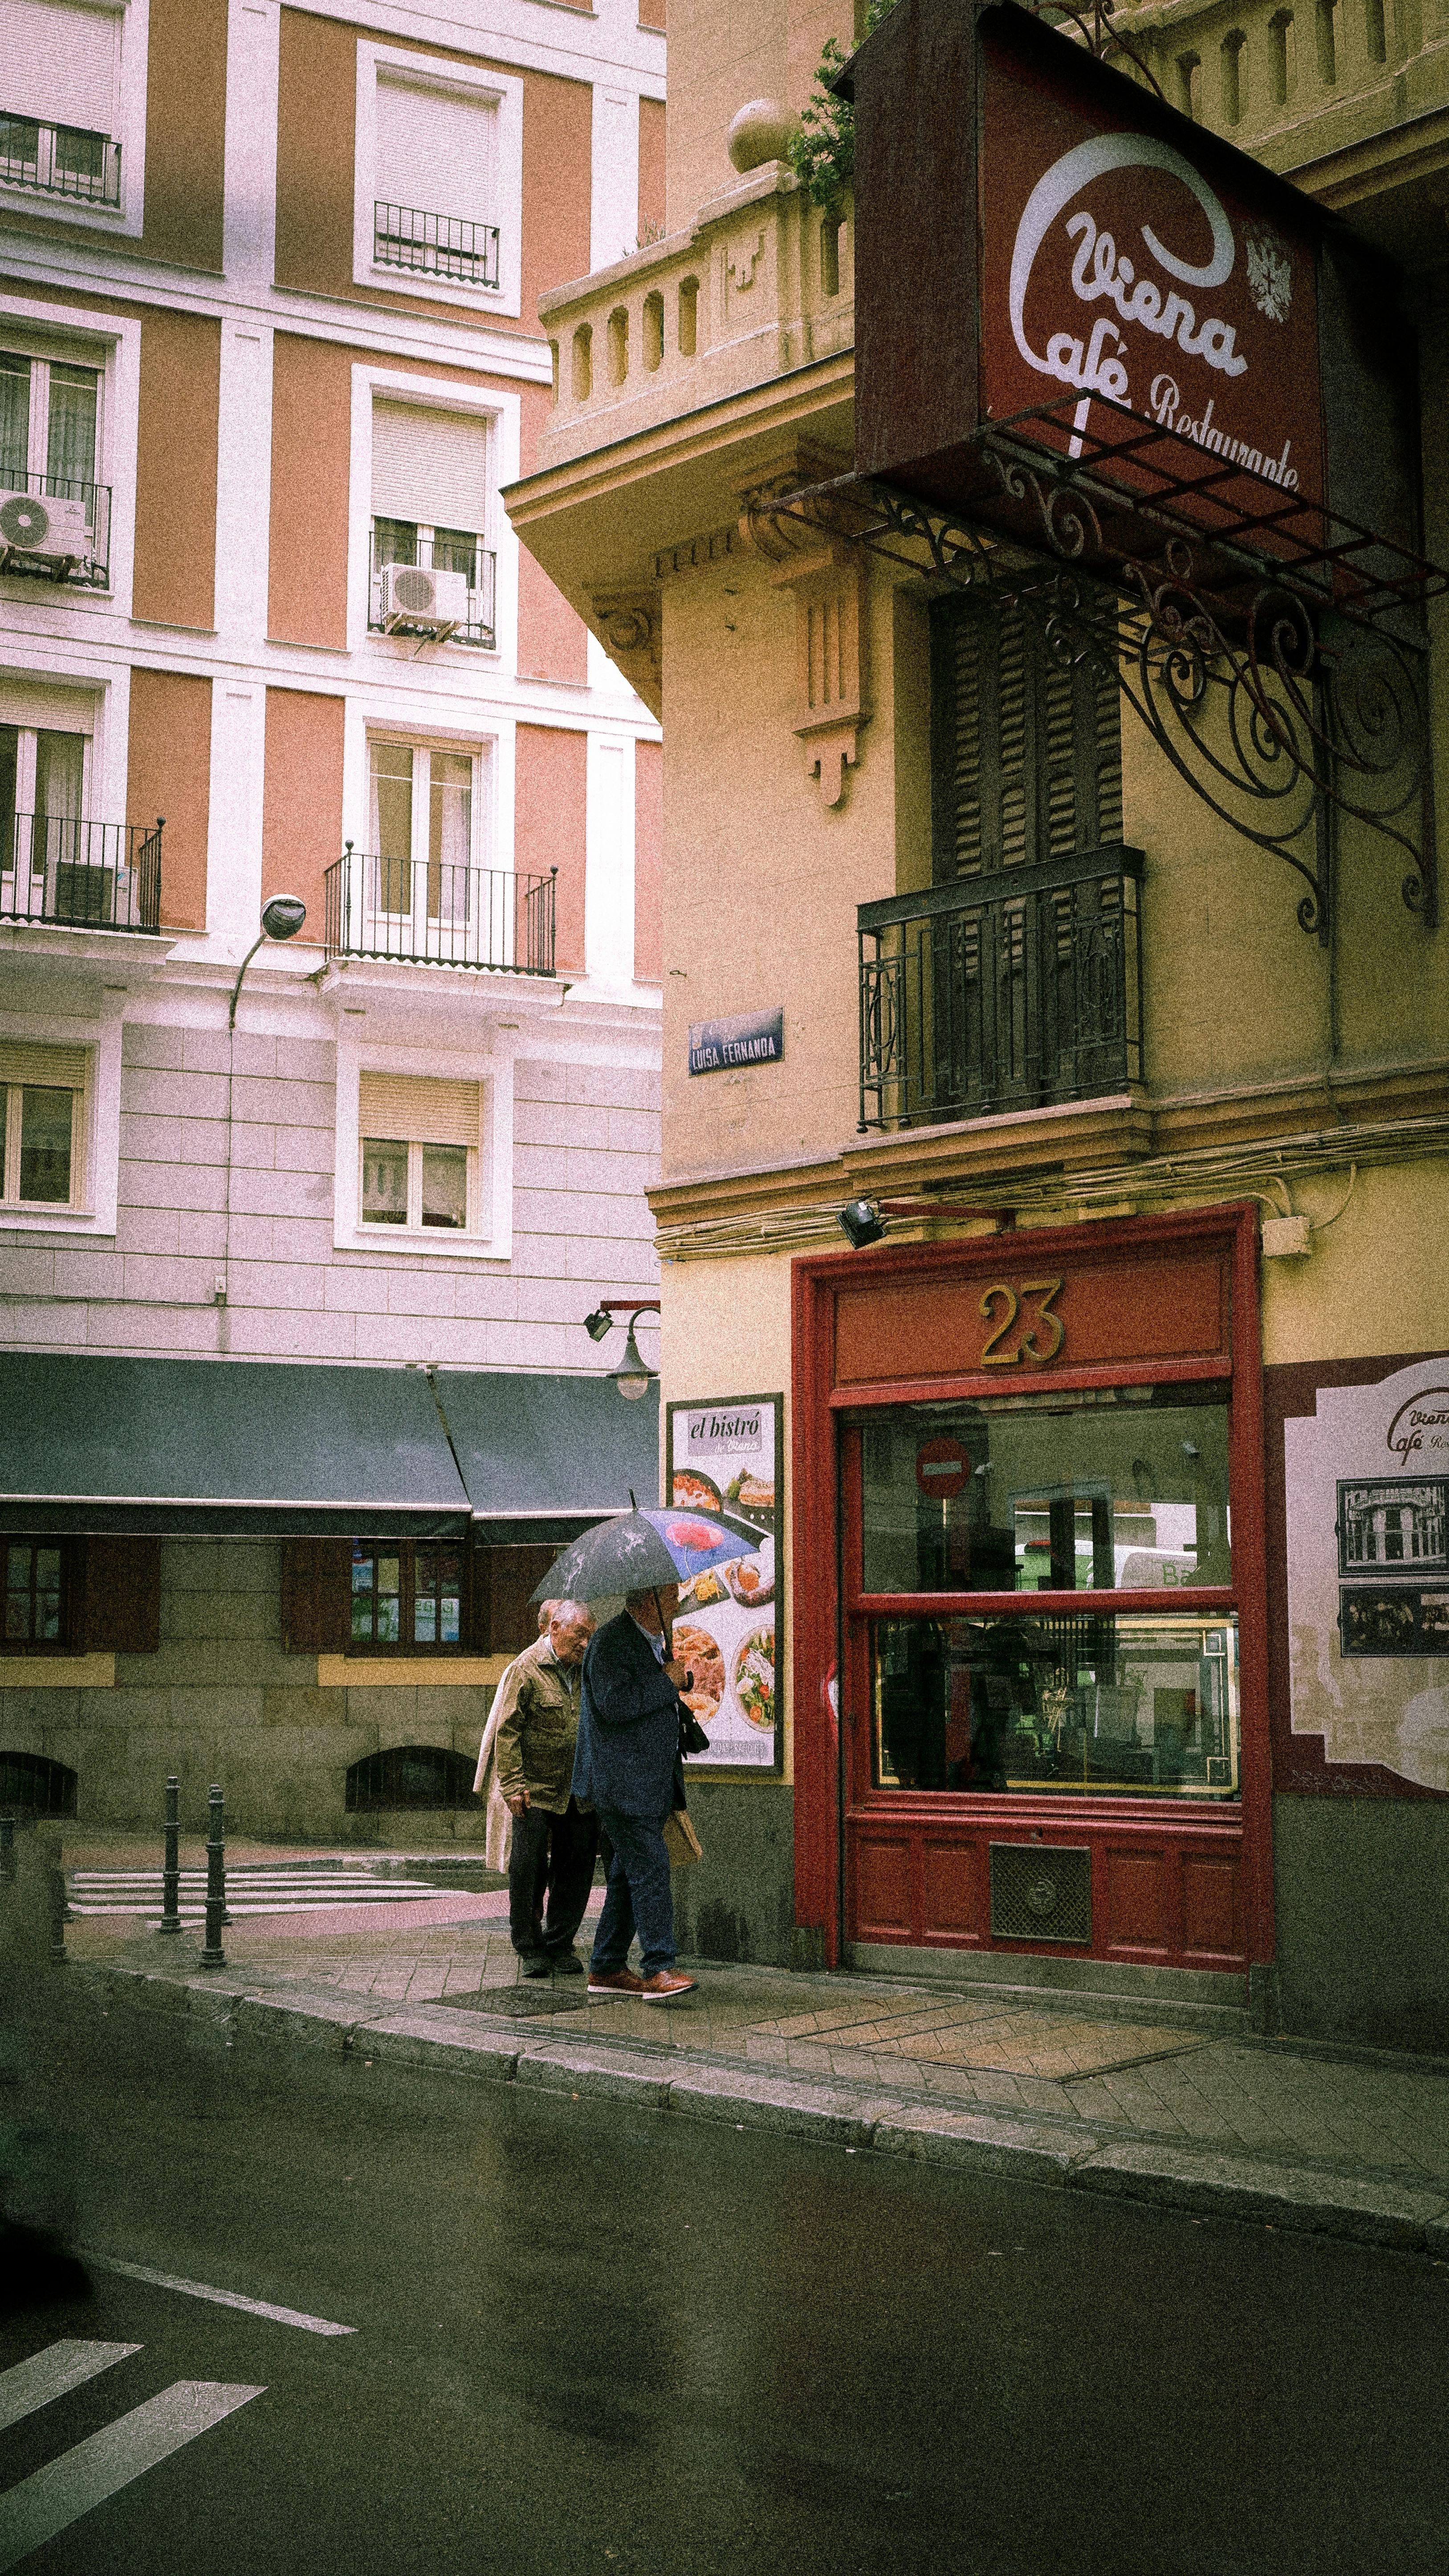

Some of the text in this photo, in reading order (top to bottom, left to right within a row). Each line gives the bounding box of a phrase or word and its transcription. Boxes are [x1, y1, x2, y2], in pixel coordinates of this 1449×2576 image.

[1066, 211, 1248, 377] Viena
[1144, 374, 1299, 492] Restaurante
[692, 1036, 776, 1070] LUISA FERNANDA
[981, 1278, 1065, 1366] 23
[691, 1411, 759, 1439] el bistró
[1409, 1410, 1449, 1426] Vien
